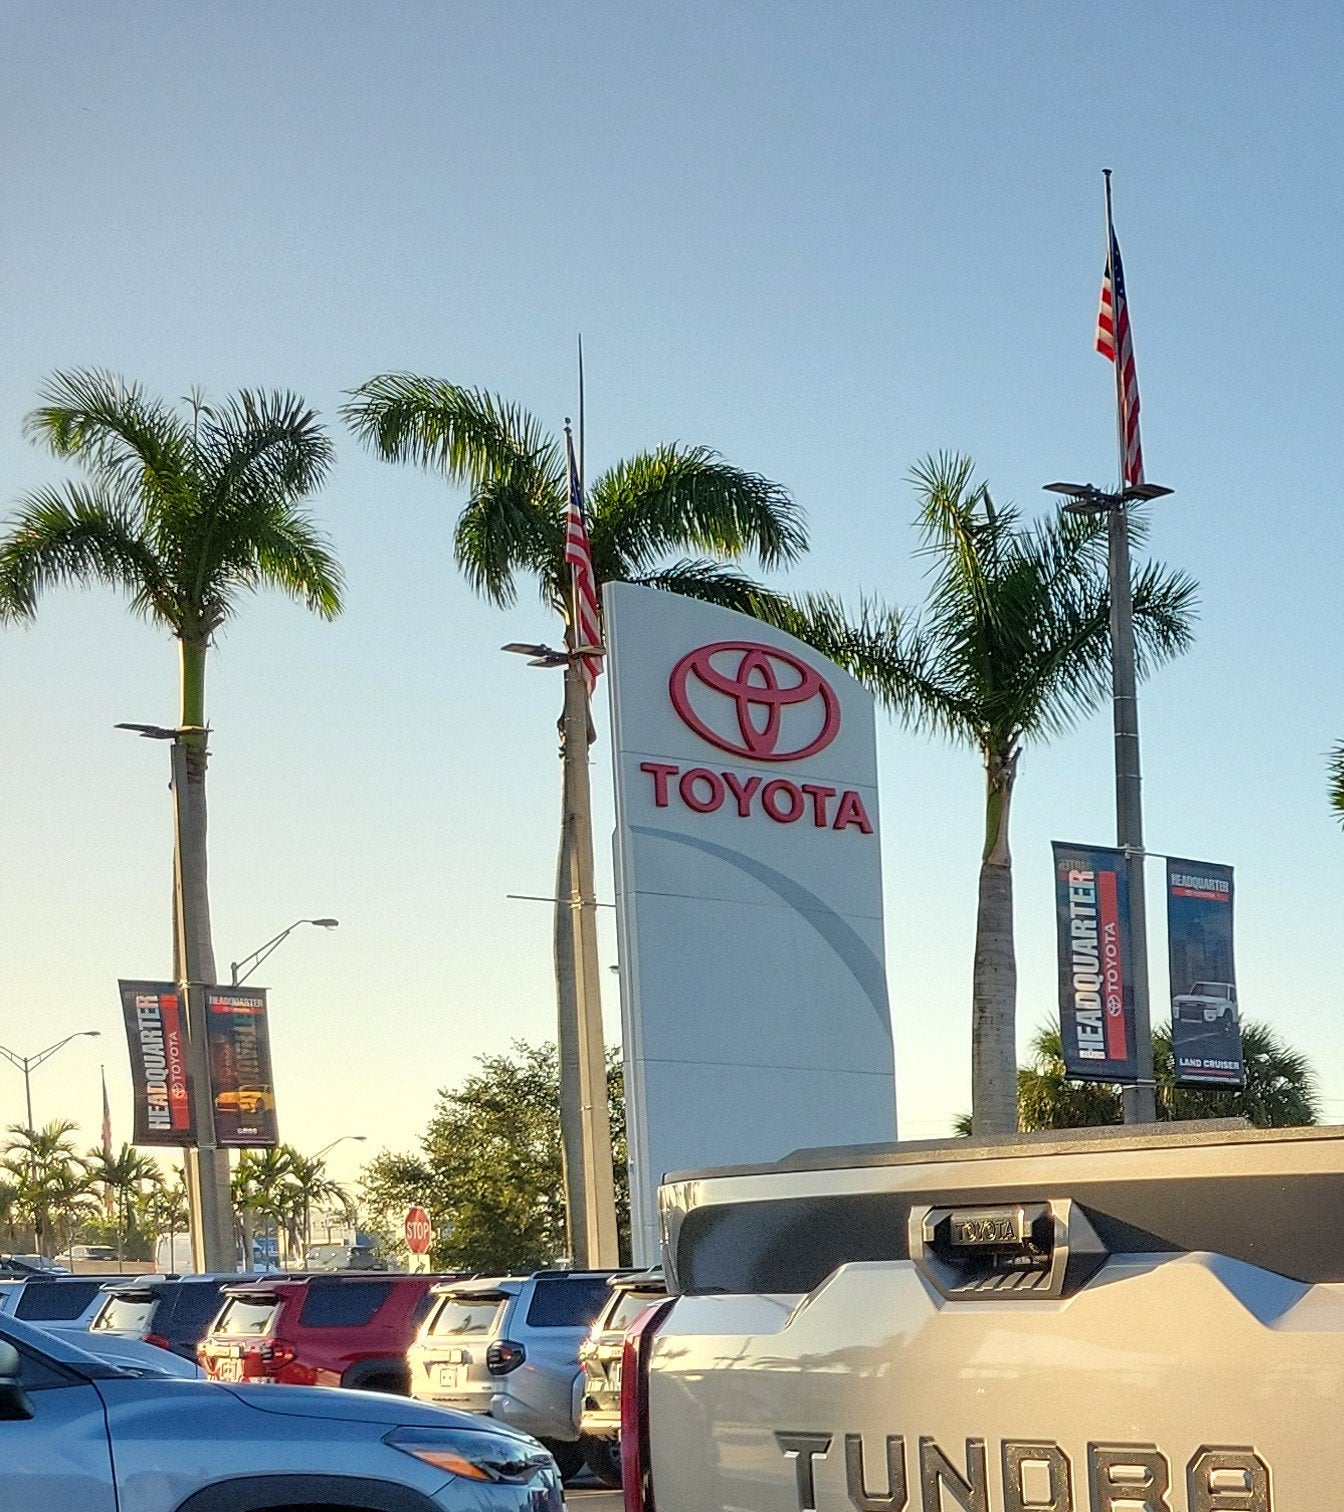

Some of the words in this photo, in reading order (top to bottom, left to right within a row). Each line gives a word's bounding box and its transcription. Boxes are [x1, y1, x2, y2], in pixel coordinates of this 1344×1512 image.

[641, 762, 874, 834] TOYOTA
[1171, 873, 1229, 893] HEADQUARTER
[1068, 869, 1106, 1060] HEADQUARTER
[1104, 922, 1121, 992] TOYOTA
[136, 995, 172, 1130] HEADQUARTER
[168, 1031, 186, 1082] TOYOTA
[1180, 1058, 1201, 1067] LAND
[1203, 1060, 1239, 1069] CRUISER
[406, 1221, 429, 1240] STOP
[956, 1220, 1017, 1242] TOYOTA
